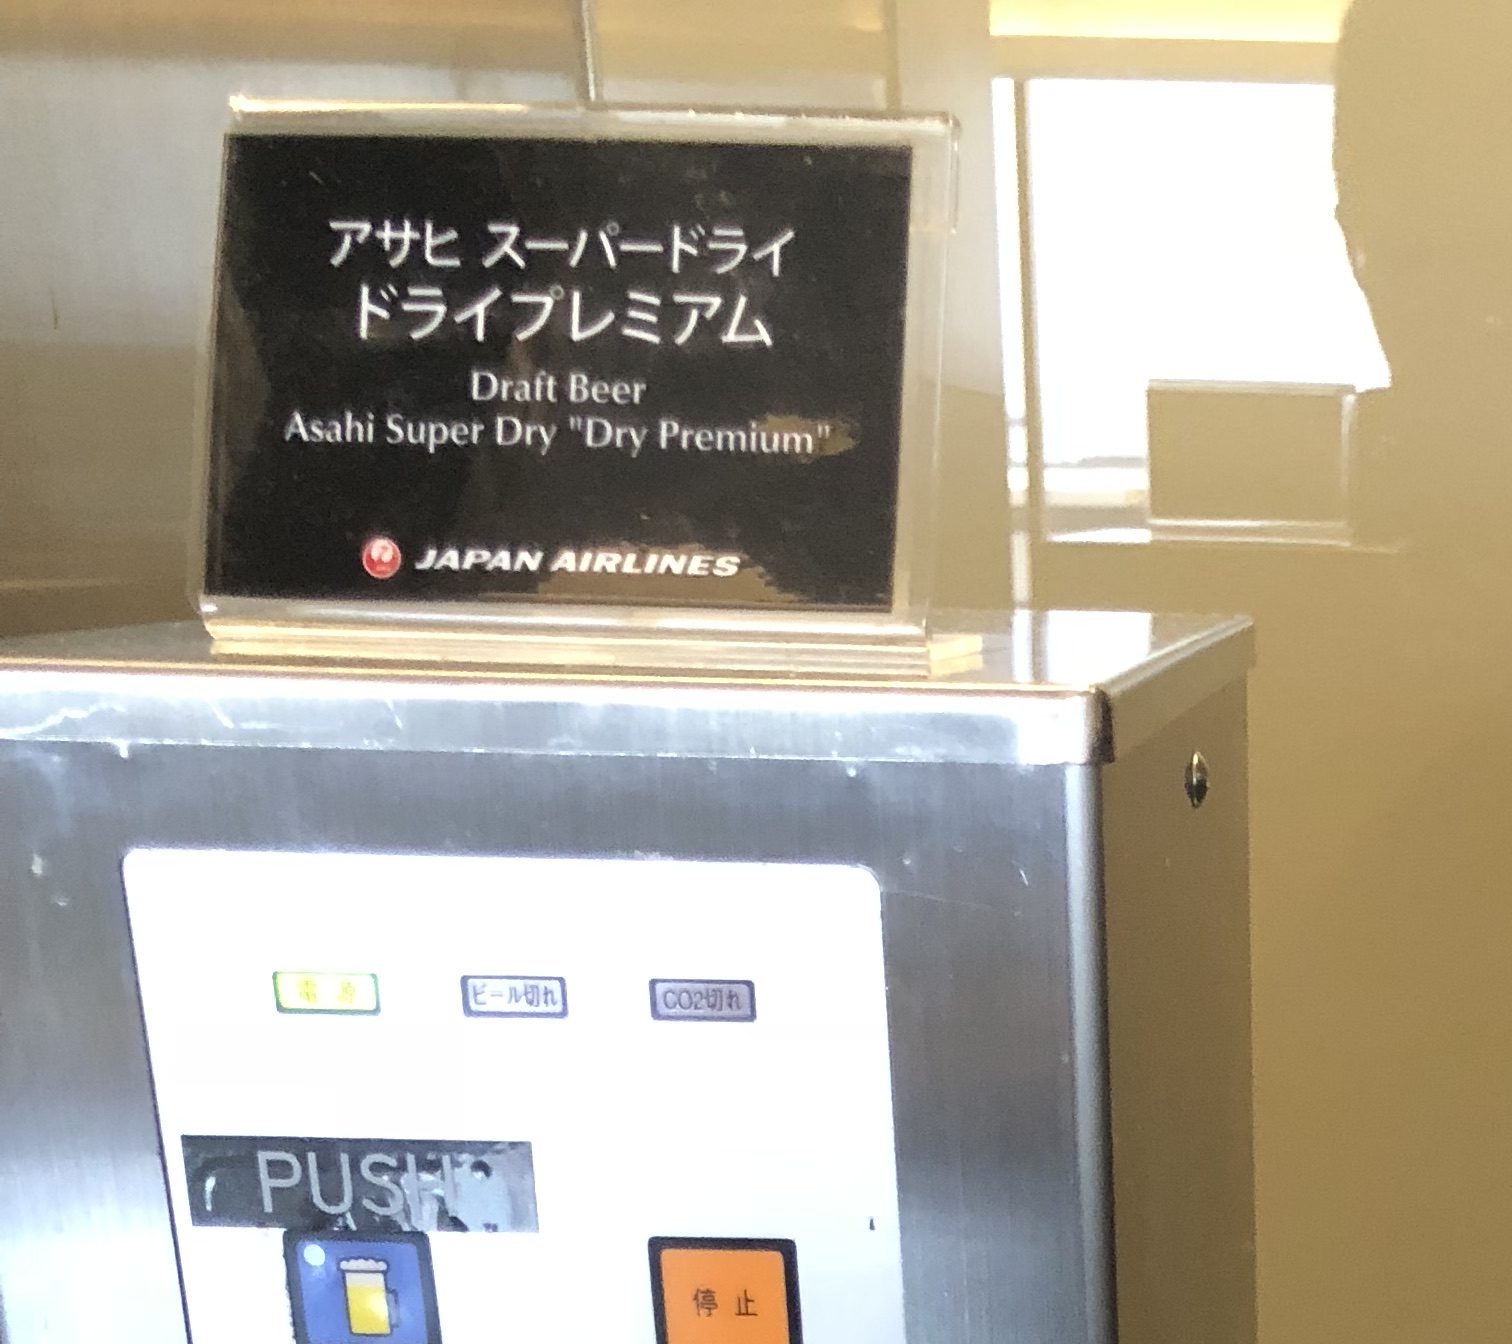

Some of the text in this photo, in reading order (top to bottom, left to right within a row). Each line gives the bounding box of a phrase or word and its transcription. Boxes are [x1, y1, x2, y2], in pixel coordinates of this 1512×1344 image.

[329, 220, 796, 277] アサヒ スーパードライ
[358, 284, 773, 348] ドライプレミアム
[471, 370, 646, 405] Draft Beer
[285, 411, 831, 458] Asahi Super Dry "Dry Premium"
[414, 545, 741, 577] JAPAN AIRLINES
[471, 984, 558, 1009] ビール切れ
[662, 987, 743, 1011] CO2切れ
[256, 1150, 455, 1219] PUSH
[691, 1288, 760, 1320] 停止
